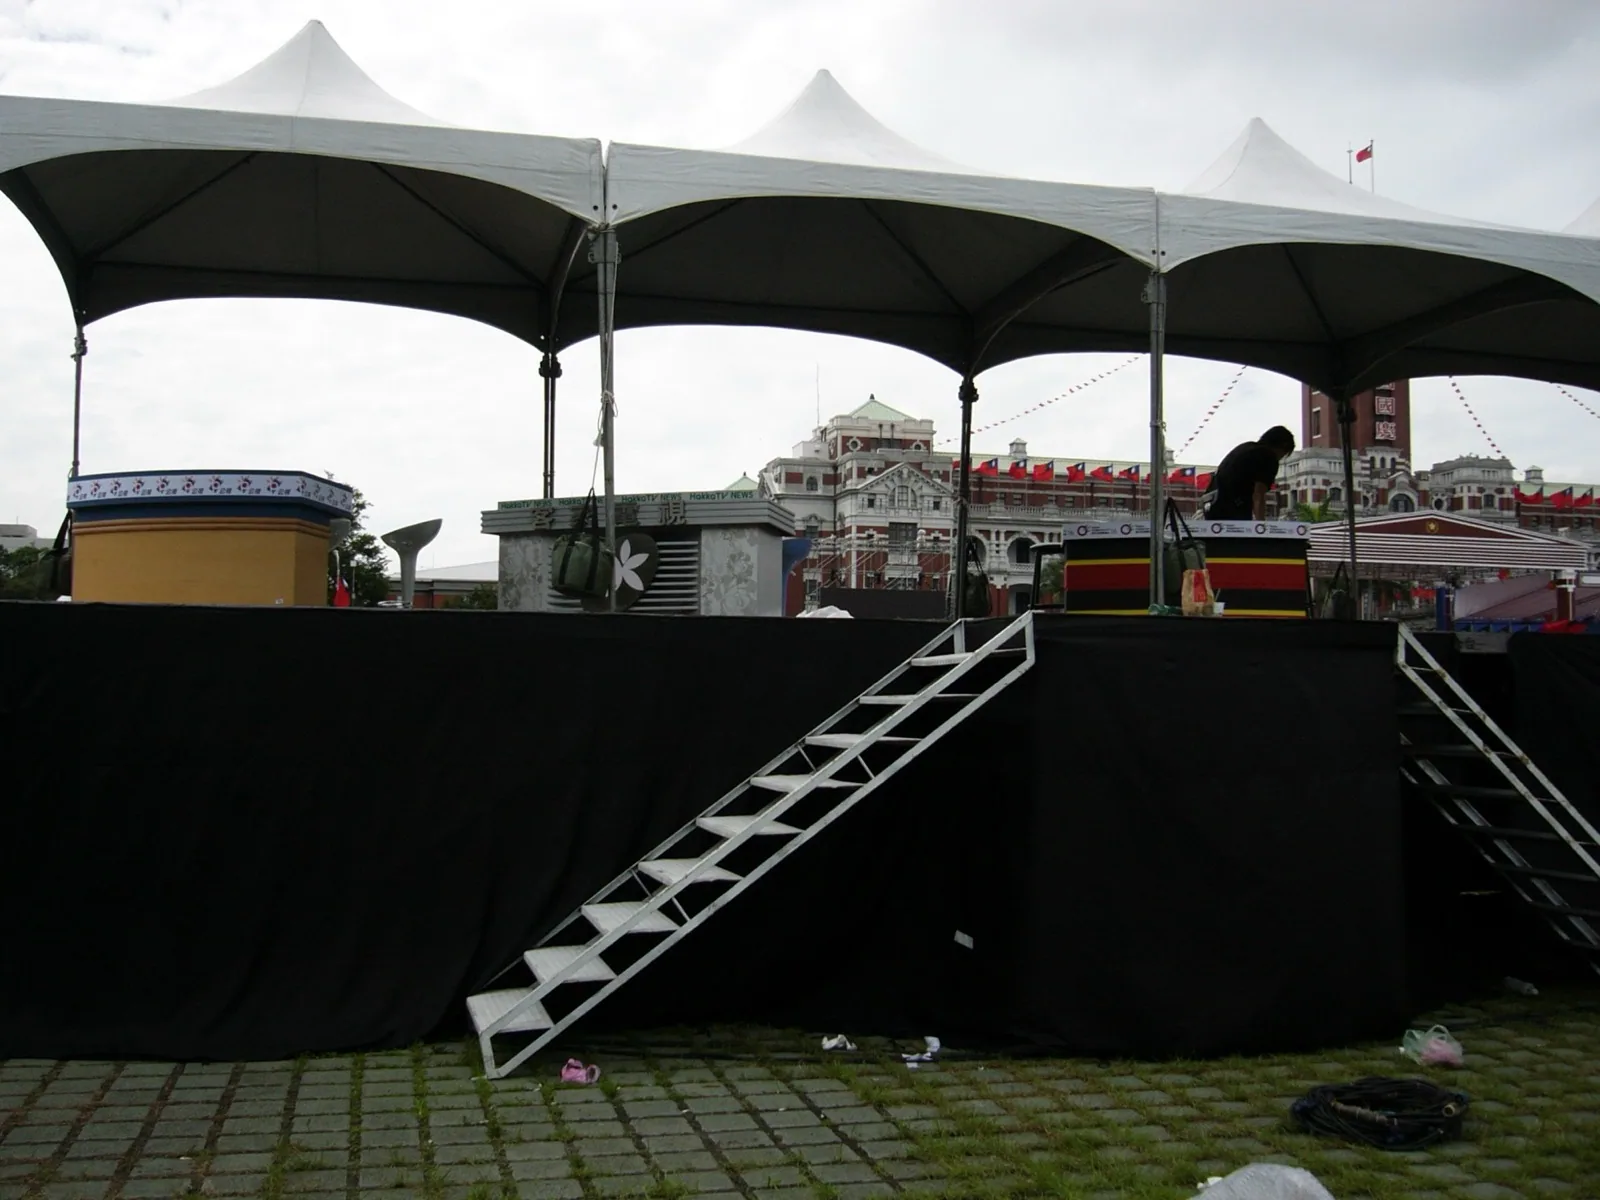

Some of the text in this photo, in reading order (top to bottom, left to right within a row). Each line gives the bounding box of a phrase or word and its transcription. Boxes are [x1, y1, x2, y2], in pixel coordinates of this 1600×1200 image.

[621, 493, 658, 503] HakkaTV
[660, 492, 682, 501] NEWS
[689, 491, 728, 501] HakkaTV
[730, 490, 754, 499] NEWS
